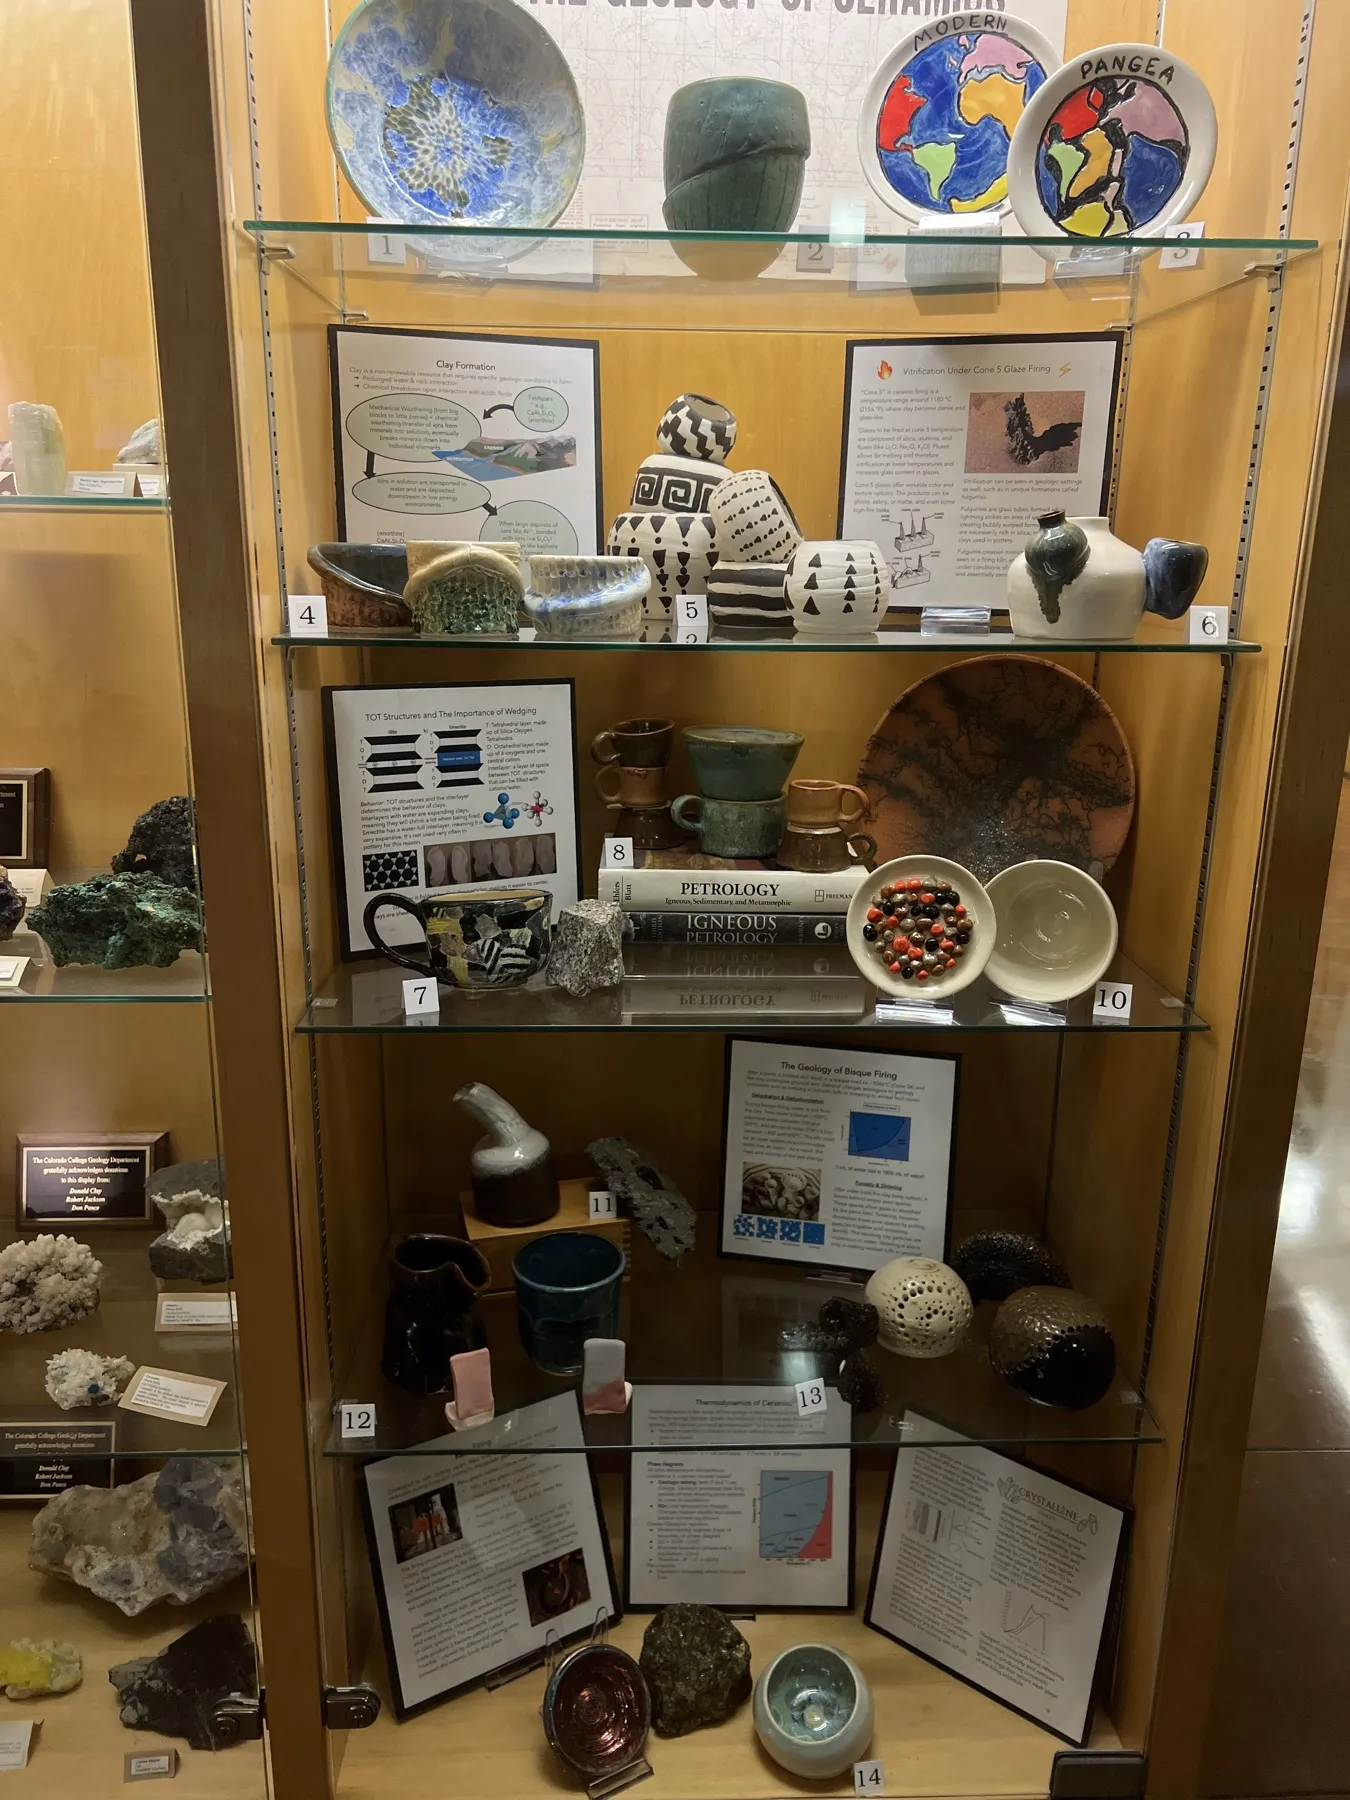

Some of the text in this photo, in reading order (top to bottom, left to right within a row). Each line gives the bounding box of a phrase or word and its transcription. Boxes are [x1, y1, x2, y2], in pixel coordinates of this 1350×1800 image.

[914, 15, 1007, 51] MODERN
[1081, 56, 1174, 85] PANGEA
[382, 235, 392, 255] 1
[808, 243, 823, 260] 2
[1174, 232, 1190, 260] 3
[436, 360, 496, 371] Clay Formation
[903, 367, 945, 375] Vitrification
[948, 366, 971, 374] Under
[974, 366, 994, 374] Cone
[1004, 365, 1026, 373] Glaze
[1028, 364, 1050, 374] Firing
[300, 606, 316, 624] 4
[686, 601, 698, 618] 5
[1202, 616, 1217, 636] 6
[384, 712, 421, 720] Structures
[454, 709, 494, 718] Importance
[496, 708, 503, 716] of
[505, 707, 536, 716] Wedging
[613, 844, 625, 860] 8
[681, 882, 780, 897] PETROLOGY
[687, 915, 777, 930] IGNEOUS
[686, 932, 778, 944] PETROLOGY
[413, 986, 427, 1004] 7
[1097, 990, 1127, 1009] 10
[781, 1061, 897, 1080] The Geology of Bisque Firing
[44, 1167, 68, 1175] gratefully
[593, 1198, 612, 1213] 11
[696, 1399, 751, 1408] Thermodynamics
[799, 1387, 822, 1408] 13
[346, 1411, 371, 1430] 12
[1020, 1487, 1078, 1520] CRYSTALLINE
[858, 1769, 880, 1787] 14
